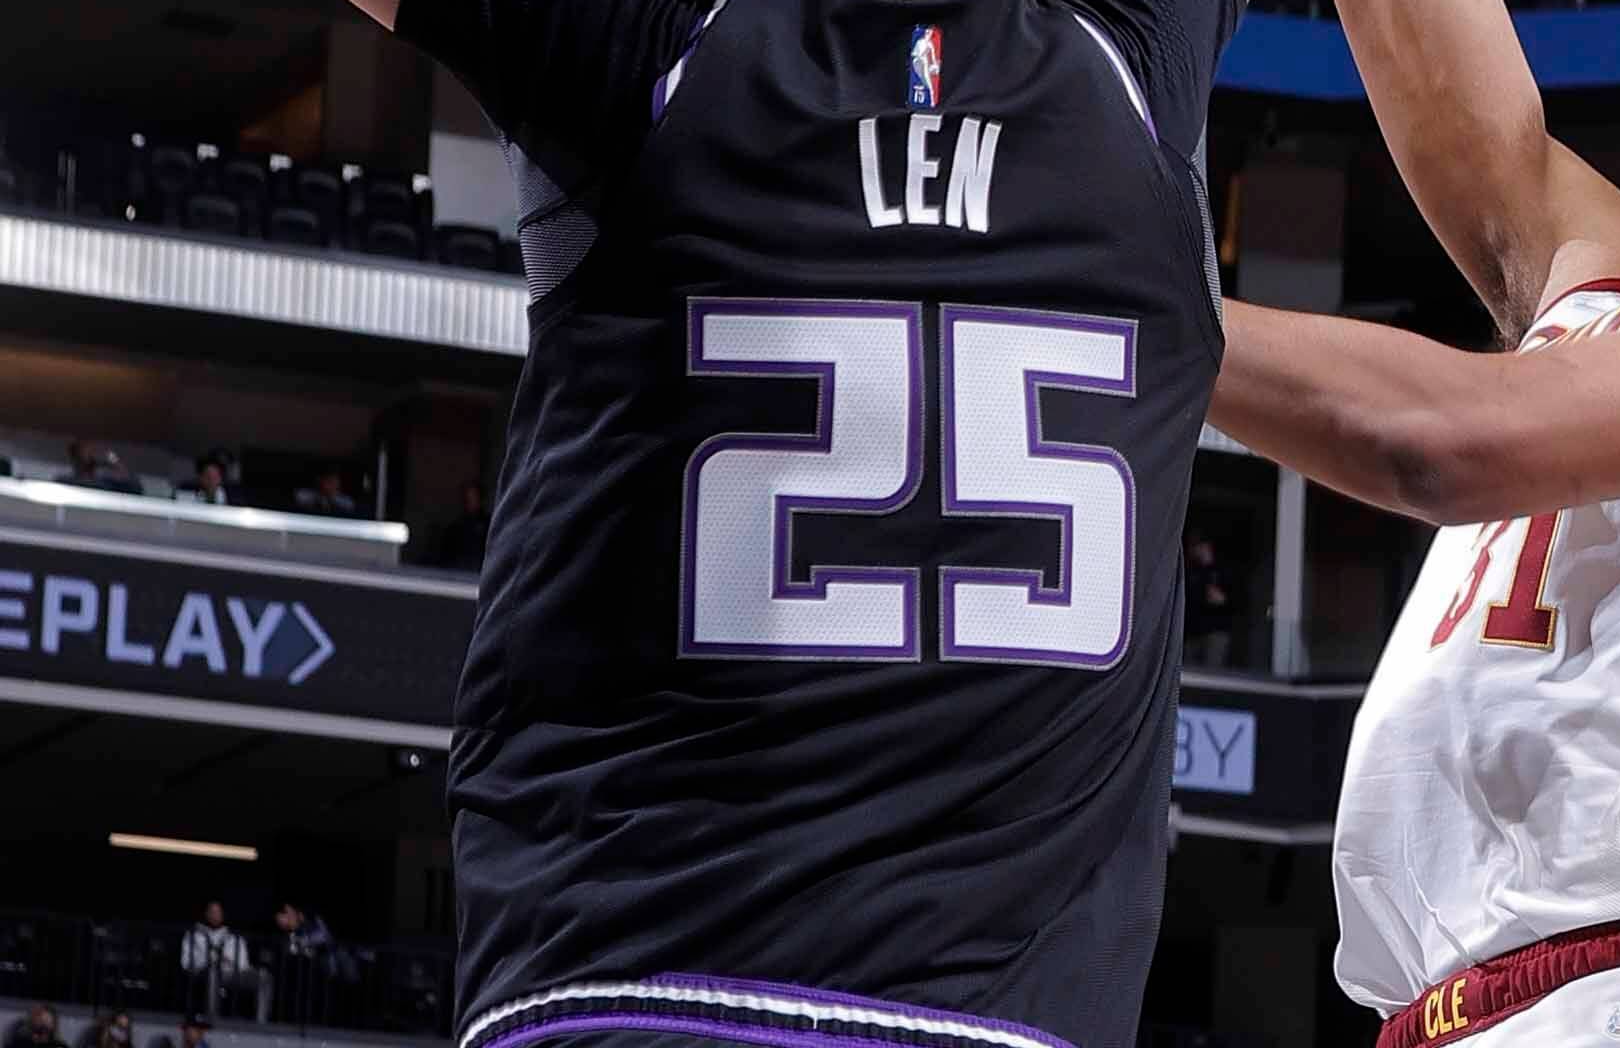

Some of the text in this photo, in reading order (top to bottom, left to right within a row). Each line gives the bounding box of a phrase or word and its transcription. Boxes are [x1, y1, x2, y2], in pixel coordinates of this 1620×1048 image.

[858, 113, 1001, 233] LEN
[677, 296, 1139, 671] 25
[0, 570, 286, 677] EPLAY
[1424, 977, 1469, 1040] CLE
